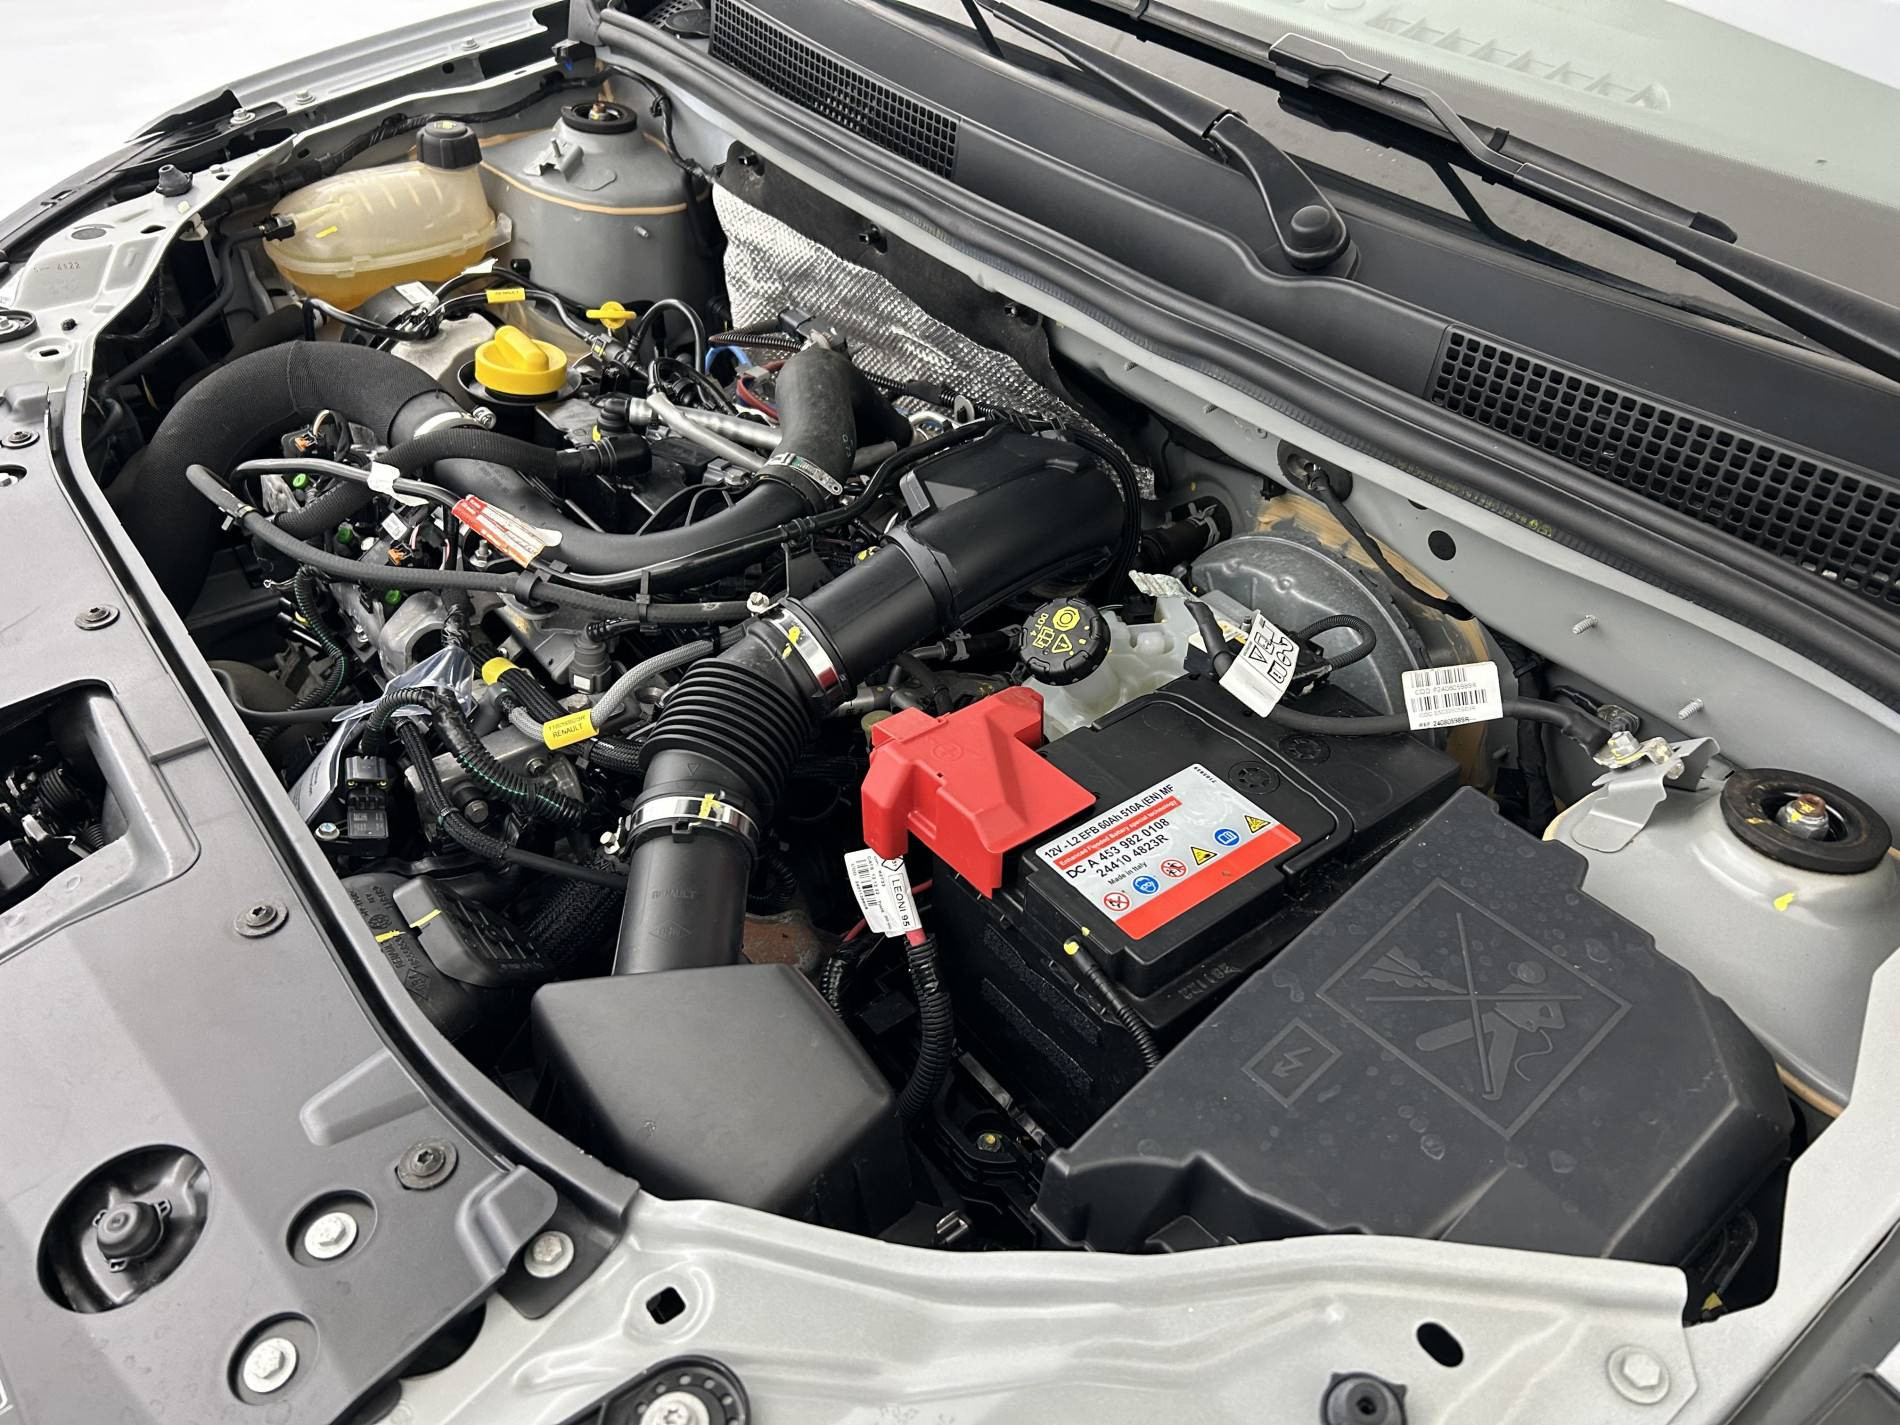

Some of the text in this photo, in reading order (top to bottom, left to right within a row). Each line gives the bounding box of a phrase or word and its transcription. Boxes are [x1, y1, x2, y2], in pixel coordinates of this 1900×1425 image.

[1034, 612, 1049, 629] DOT
[552, 723, 583, 738] RENAULT
[1044, 845, 1063, 859] 12V
[1066, 836, 1081, 847] L2
[1078, 826, 1100, 841] EFB
[1097, 814, 1123, 830] 60Ah
[1120, 802, 1145, 817] 510A
[1141, 791, 1164, 807] (EN)
[1159, 784, 1174, 796] MF
[1059, 848, 1088, 865] Enhanced
[1108, 825, 1130, 838] Battery
[1146, 799, 1178, 818] technology
[1066, 818, 1170, 879] DC A 453 982 0108
[1096, 834, 1169, 878] 24410 4823R
[1107, 871, 1127, 886] Made
[1132, 861, 1148, 873] Italy
[891, 878, 911, 927] LEONI 95
